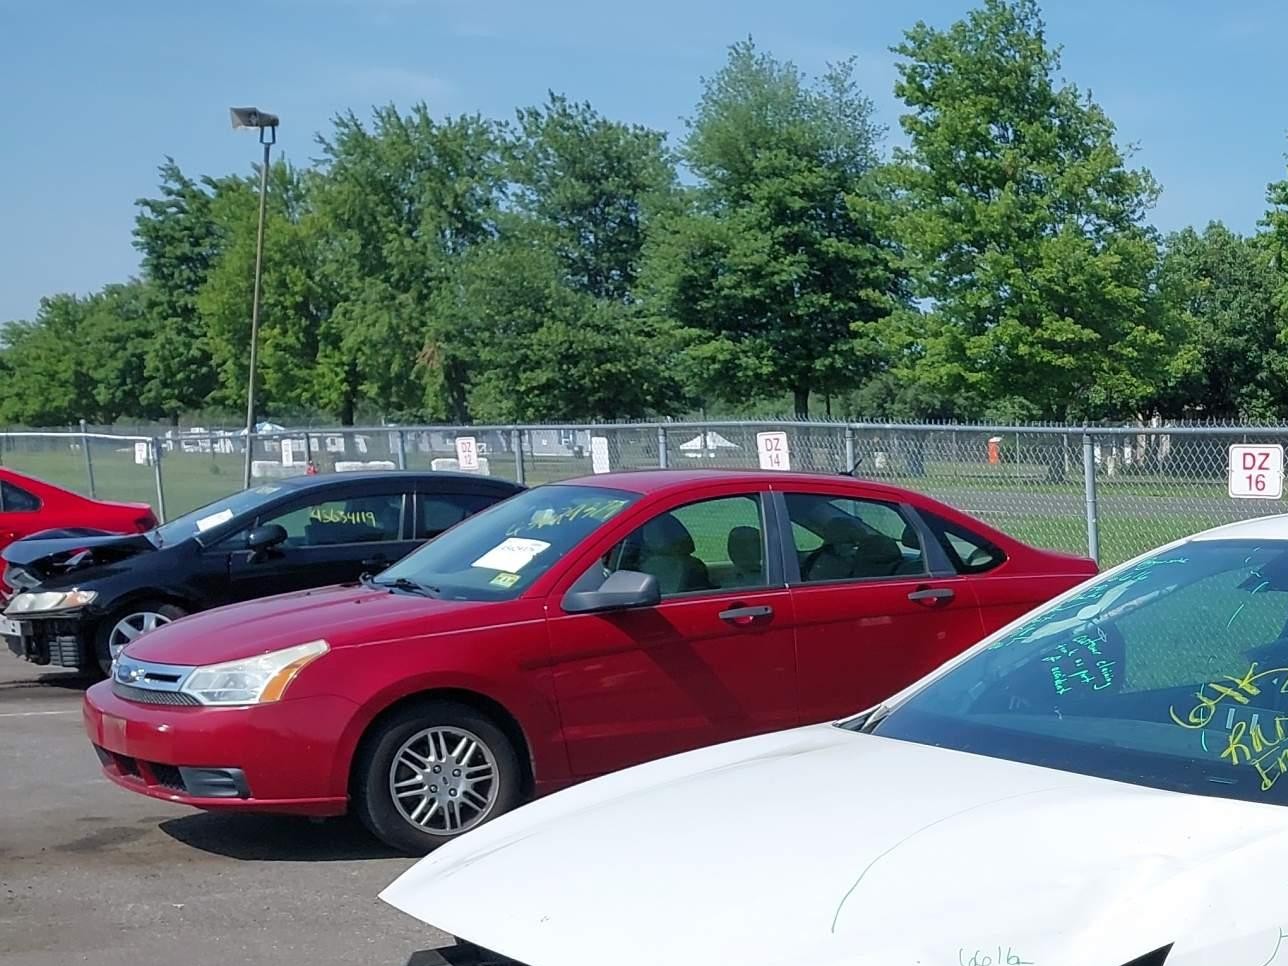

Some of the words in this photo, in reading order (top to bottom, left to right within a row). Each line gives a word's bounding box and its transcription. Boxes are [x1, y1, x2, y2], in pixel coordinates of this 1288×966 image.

[764, 438, 782, 451] DZ
[769, 453, 781, 467] 14
[1242, 452, 1270, 470] DZ
[1245, 473, 1266, 491] 16
